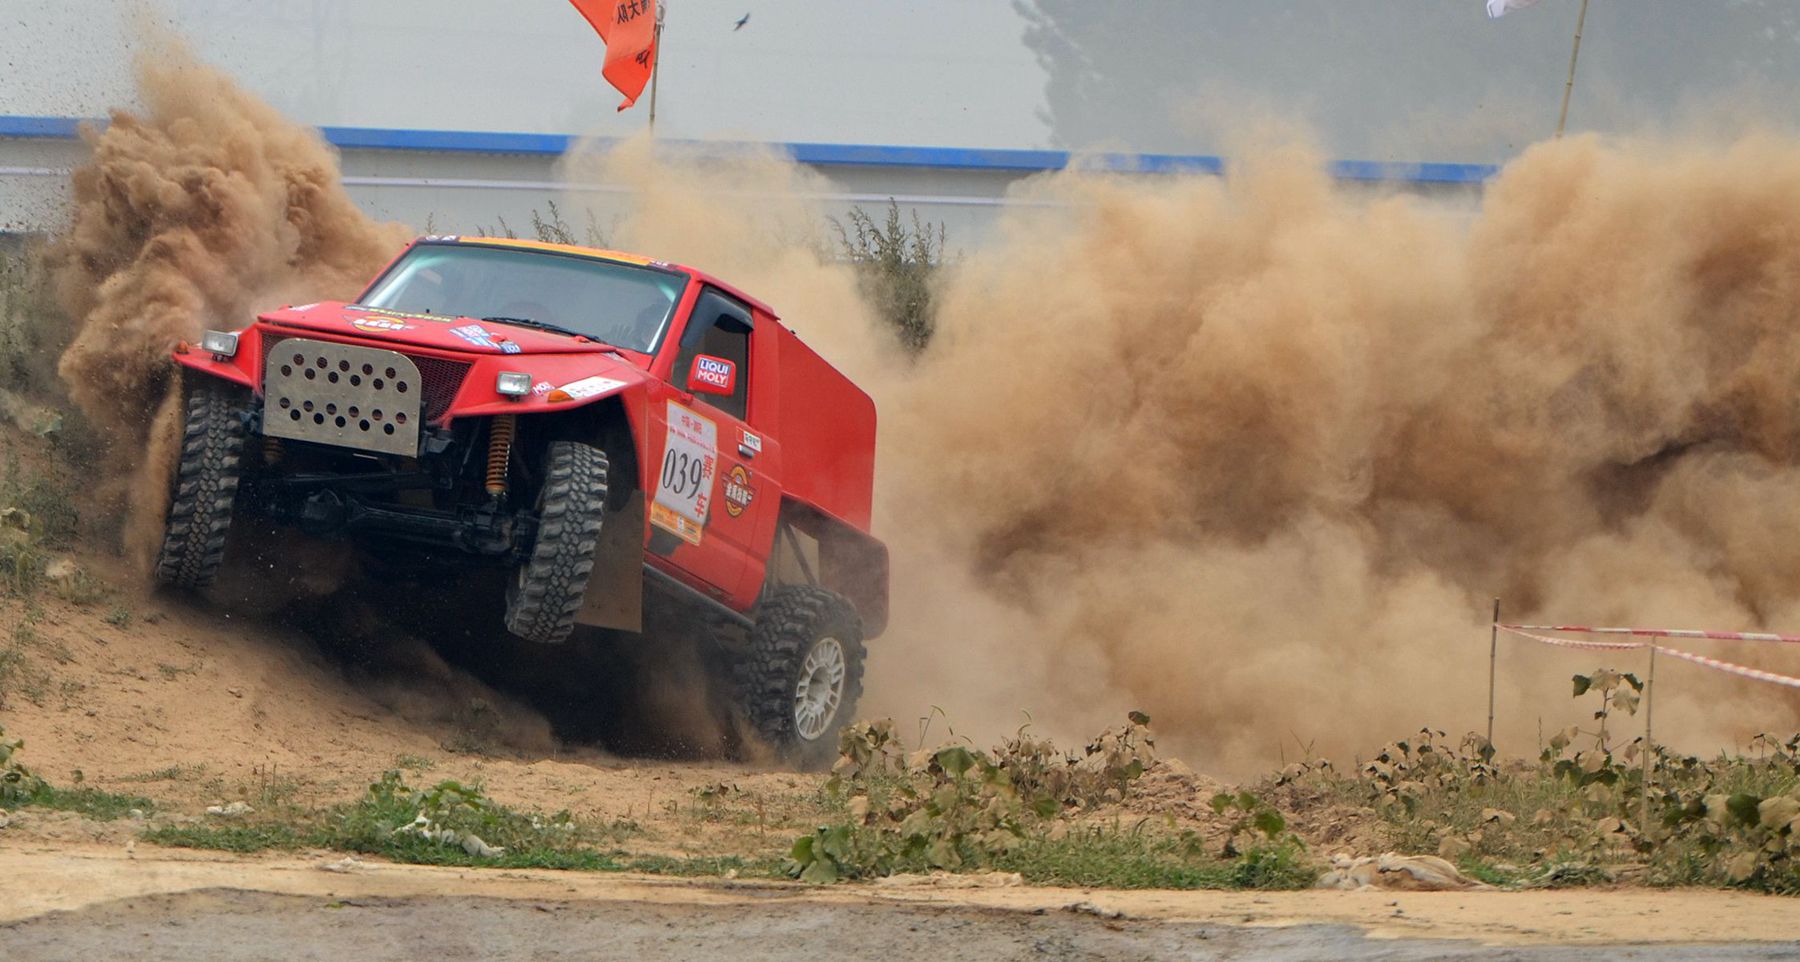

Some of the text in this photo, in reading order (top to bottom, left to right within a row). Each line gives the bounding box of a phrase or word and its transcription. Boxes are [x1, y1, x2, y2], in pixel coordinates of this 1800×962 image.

[700, 359, 729, 375] LIQUI
[697, 370, 726, 385] MOLY
[662, 448, 702, 500] 039
